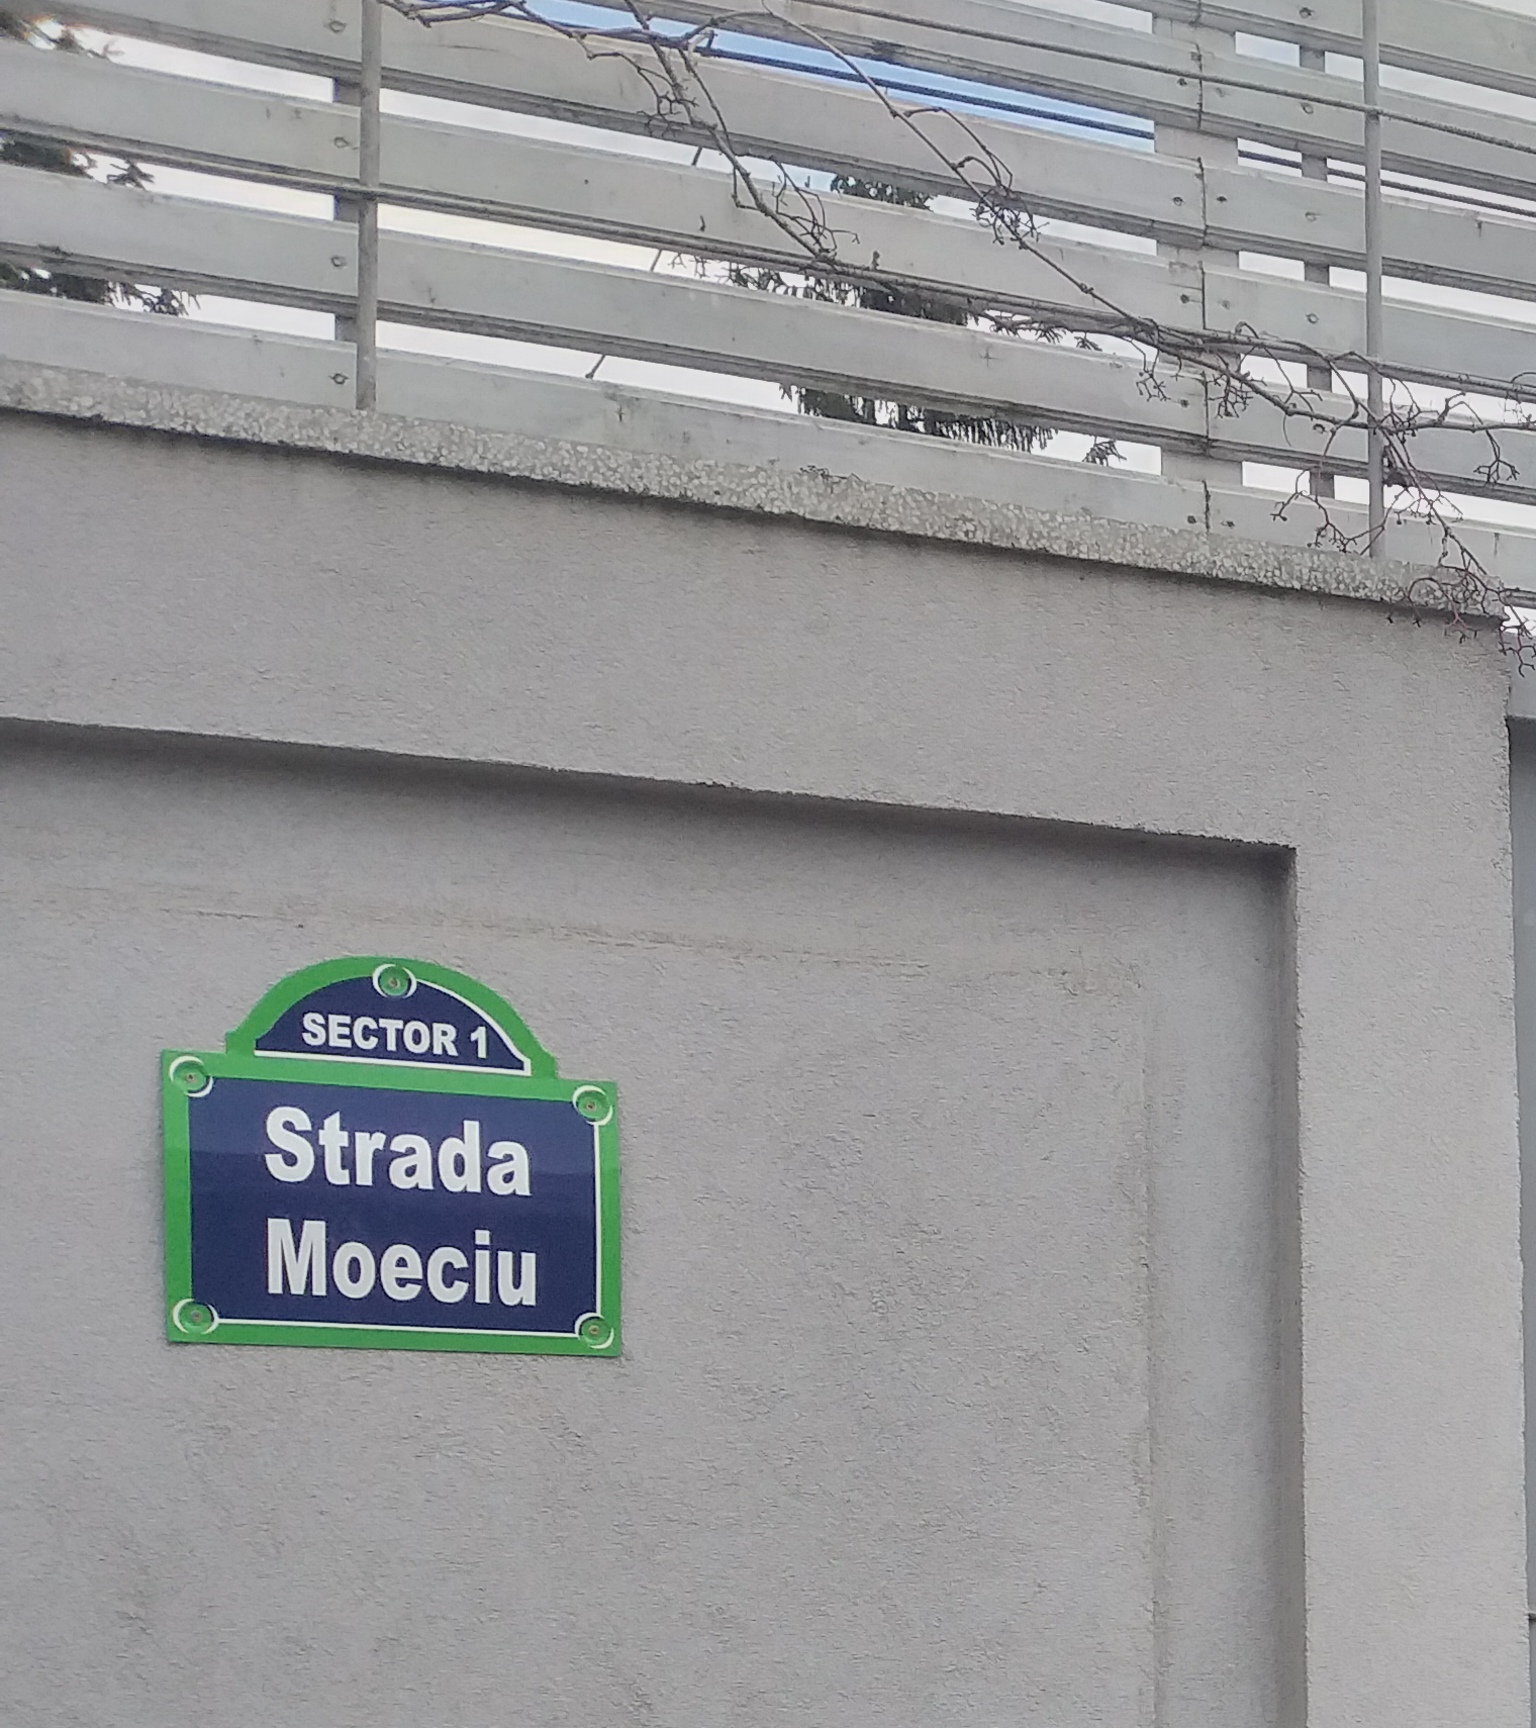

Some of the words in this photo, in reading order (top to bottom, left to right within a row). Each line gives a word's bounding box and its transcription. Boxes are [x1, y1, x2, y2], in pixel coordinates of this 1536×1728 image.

[301, 1011, 458, 1057] SECTOR
[469, 1025, 489, 1059] 1
[264, 1105, 532, 1197] Strada
[266, 1217, 538, 1307] Moeciu
